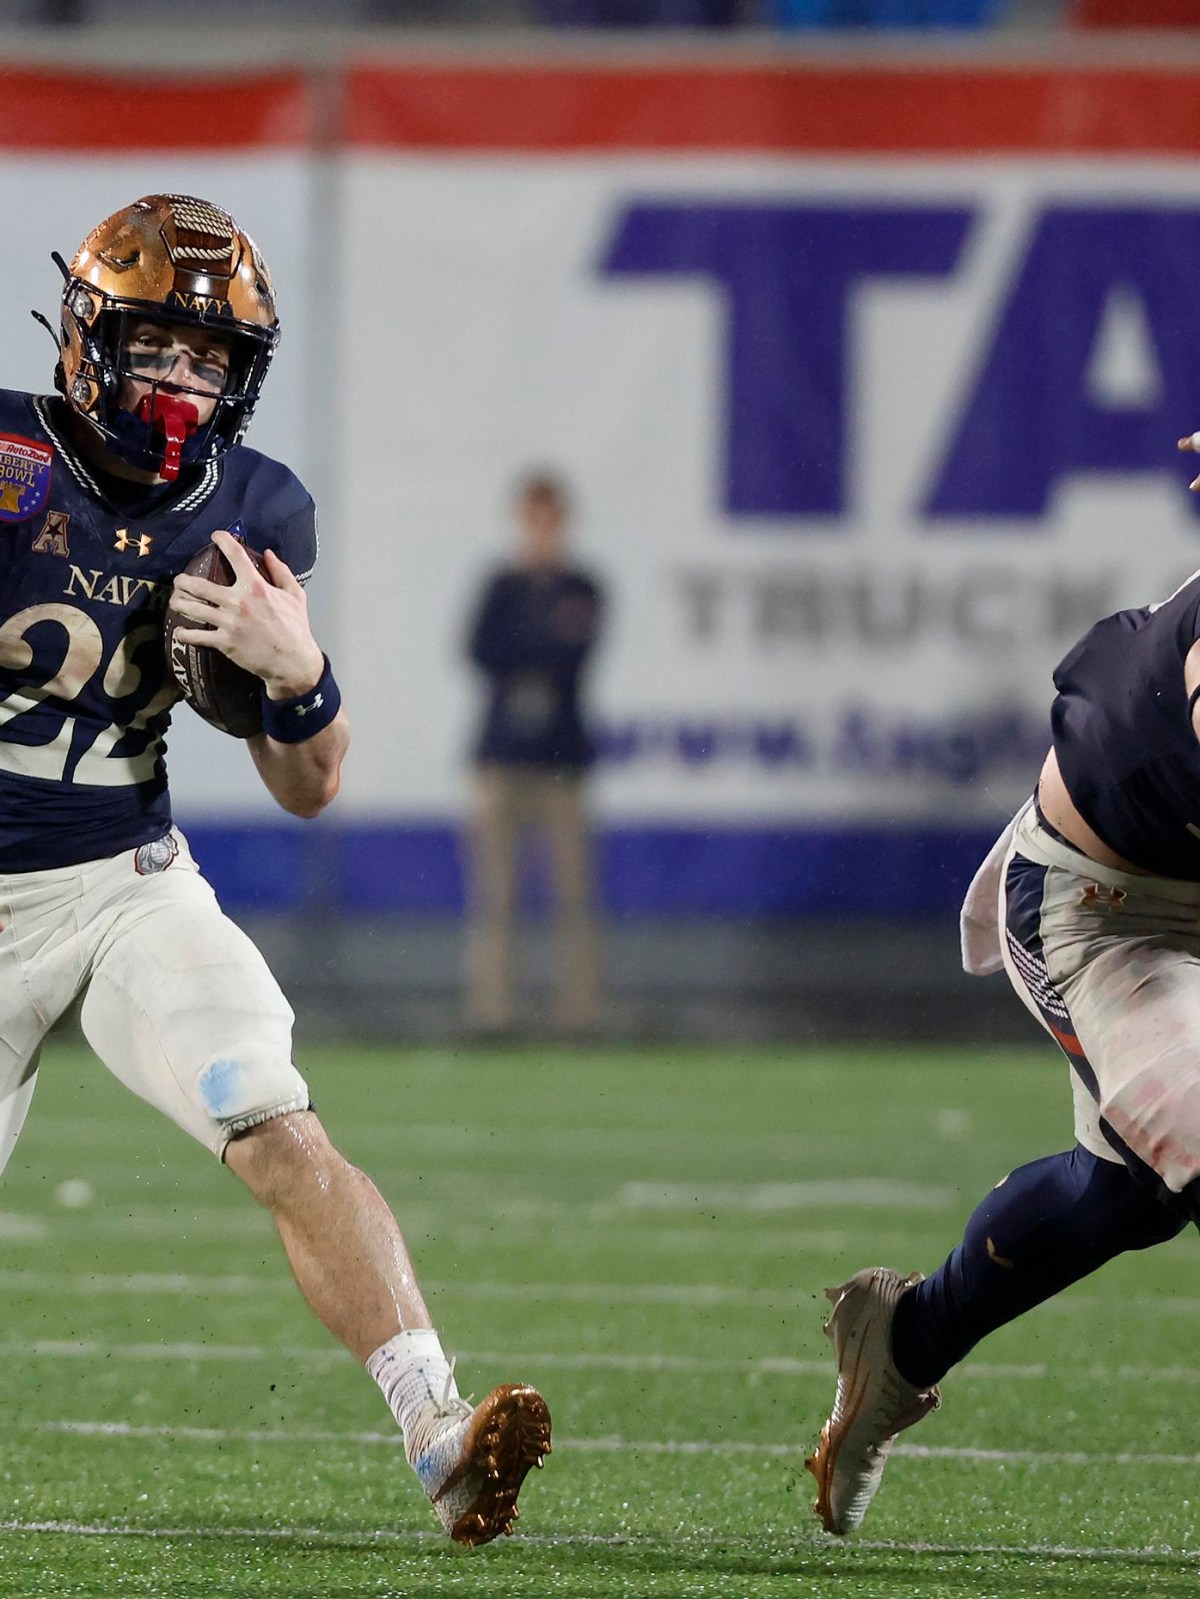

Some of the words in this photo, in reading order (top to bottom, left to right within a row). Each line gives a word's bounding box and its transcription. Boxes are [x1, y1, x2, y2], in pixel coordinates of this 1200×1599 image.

[174, 291, 226, 315] NAVY
[6, 444, 49, 463] AutoZone
[171, 627, 193, 698] AVY
